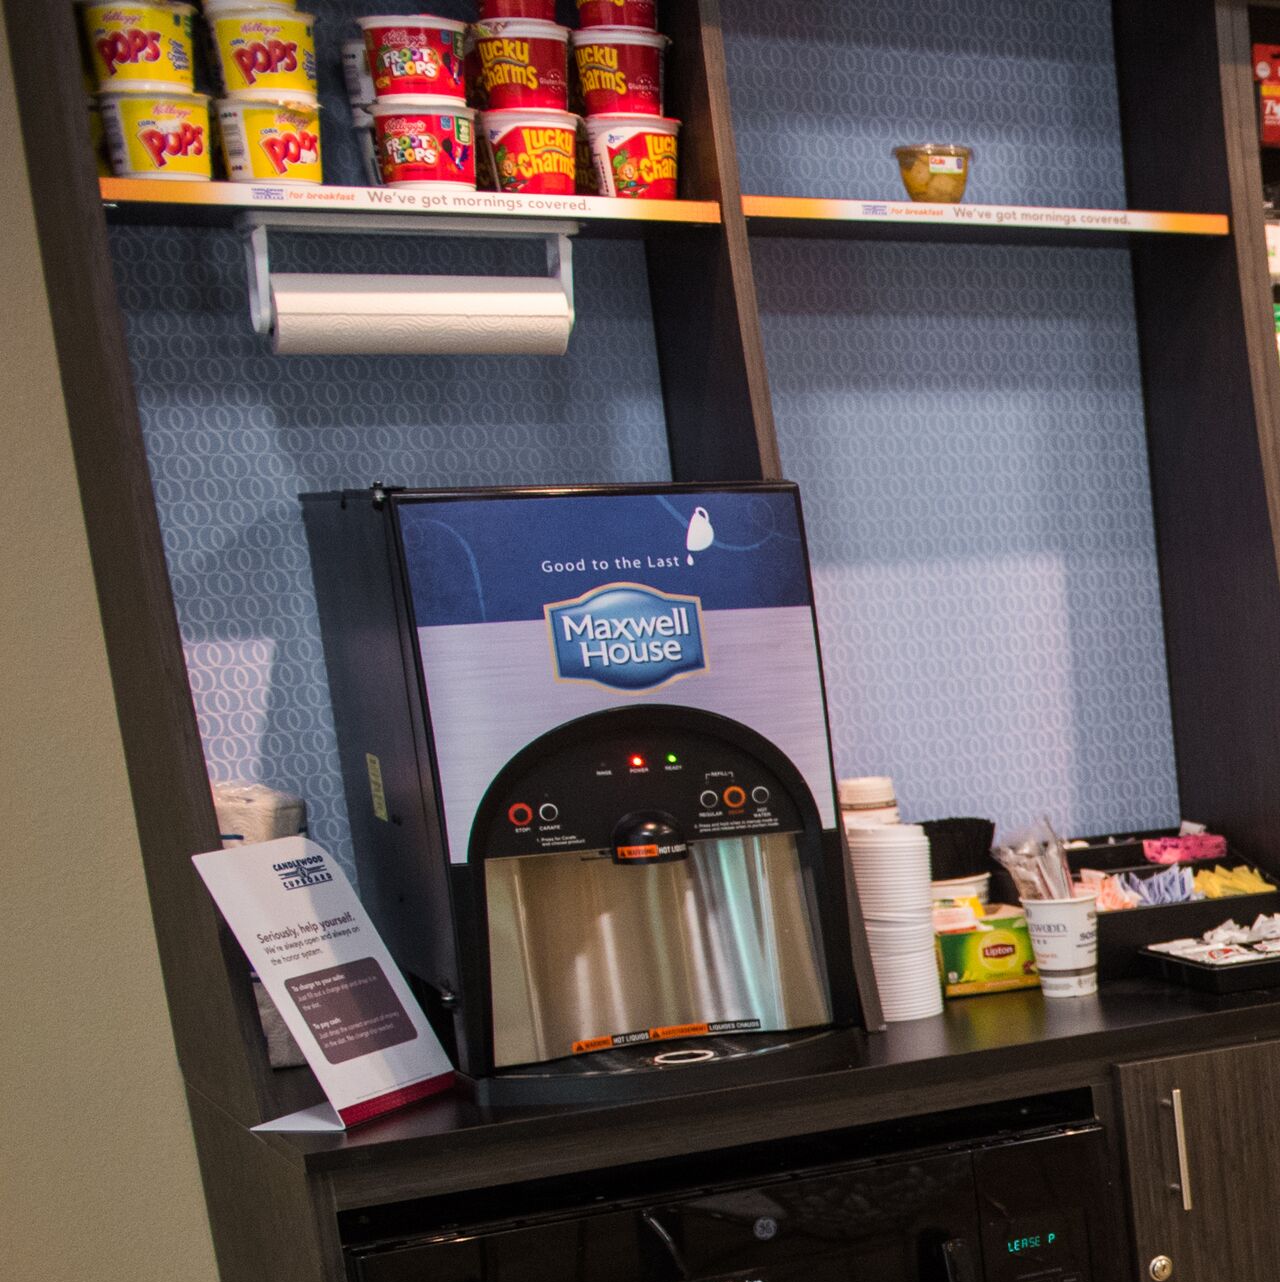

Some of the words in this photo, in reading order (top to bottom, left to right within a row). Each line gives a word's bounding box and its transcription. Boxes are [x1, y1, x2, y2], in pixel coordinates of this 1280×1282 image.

[96, 28, 161, 76] POPS
[232, 39, 298, 85] POPS
[383, 47, 431, 67] FROOT
[391, 61, 439, 78] LOOPS
[137, 122, 204, 168] POPS
[386, 134, 431, 155] FROOT
[521, 128, 575, 158] Lucky
[393, 148, 437, 165] LOOPS
[517, 152, 576, 181] Charms
[289, 192, 304, 200] for
[305, 192, 356, 202] breakfast
[367, 190, 417, 205] We've
[421, 195, 448, 208] got
[452, 196, 523, 211] mornings
[527, 199, 593, 212] covered.
[904, 208, 944, 216] breakfast
[953, 206, 992, 219] We've
[995, 210, 1017, 225] got
[1020, 211, 1077, 225] mornings
[1080, 212, 1131, 225] covered.
[541, 558, 586, 573] Good
[592, 558, 609, 571] to
[614, 556, 642, 570] the
[647, 554, 681, 569] Last
[561, 605, 690, 642] Maxwell
[578, 638, 683, 669] House
[538, 824, 561, 832] CARAFE
[658, 845, 672, 854] HOT
[272, 854, 324, 872] CANDLEWOOD
[282, 872, 333, 889] CUPBOARD
[256, 923, 301, 945] Seriously,
[296, 920, 320, 937] help
[318, 910, 356, 932] yourself.
[984, 946, 1014, 957] Lipton
[708, 1022, 736, 1032] LIQUIDES
[736, 1019, 761, 1029] CHAUDS
[612, 1036, 626, 1045] HOT
[625, 1032, 650, 1042] LIQUIDS
[1007, 1235, 1042, 1253] LEASE
[1047, 1232, 1056, 1244] P
